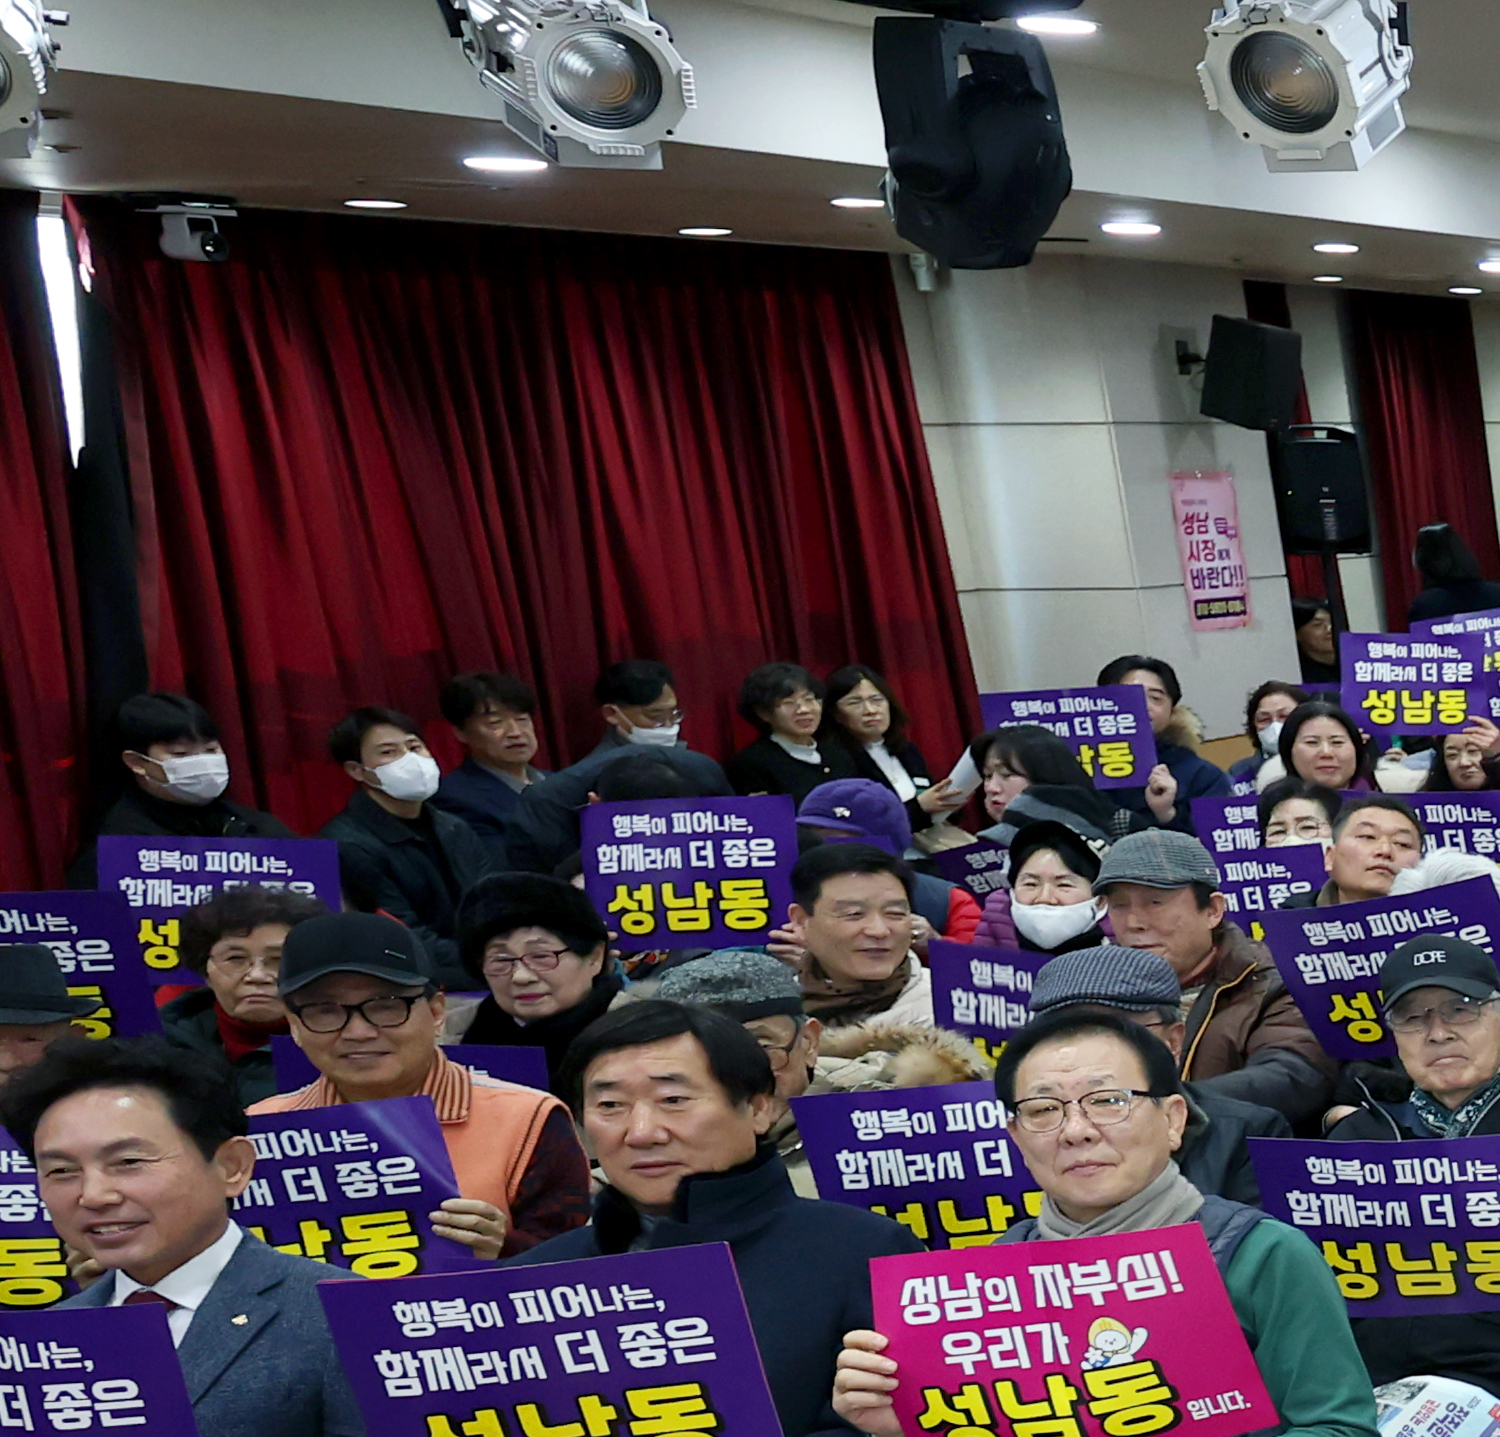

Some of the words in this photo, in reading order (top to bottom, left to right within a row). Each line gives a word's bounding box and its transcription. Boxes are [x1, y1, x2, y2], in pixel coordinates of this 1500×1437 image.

[1183, 512, 1209, 535] 성남
[1190, 565, 1244, 590] 바란다!!
[1368, 642, 1407, 658] 행복이
[1411, 643, 1461, 659] 피어나는,
[1355, 661, 1416, 682] 함께라서
[1442, 663, 1472, 682] 좋은
[1362, 689, 1468, 725] 성남동
[613, 815, 666, 837] 행복이
[672, 812, 753, 833] 피어나는,
[597, 844, 681, 873] 함께라서
[722, 839, 776, 867] 좋은
[606, 877, 771, 936] 성남동
[1414, 951, 1446, 966] DOPE
[1306, 1157, 1386, 1185] 행복이
[1286, 1191, 1411, 1227] 함께라서
[900, 1273, 1021, 1325] 성남의
[1029, 1250, 1183, 1309] 자부심!
[393, 1298, 504, 1337] 행복이
[509, 1284, 665, 1323] 피어나는,
[374, 1347, 547, 1396] 함께라서
[555, 1330, 609, 1373] 더
[617, 1318, 716, 1367] 좋은
[942, 1322, 1070, 1375] 우리가
[1187, 1391, 1251, 1420] 입니다.
